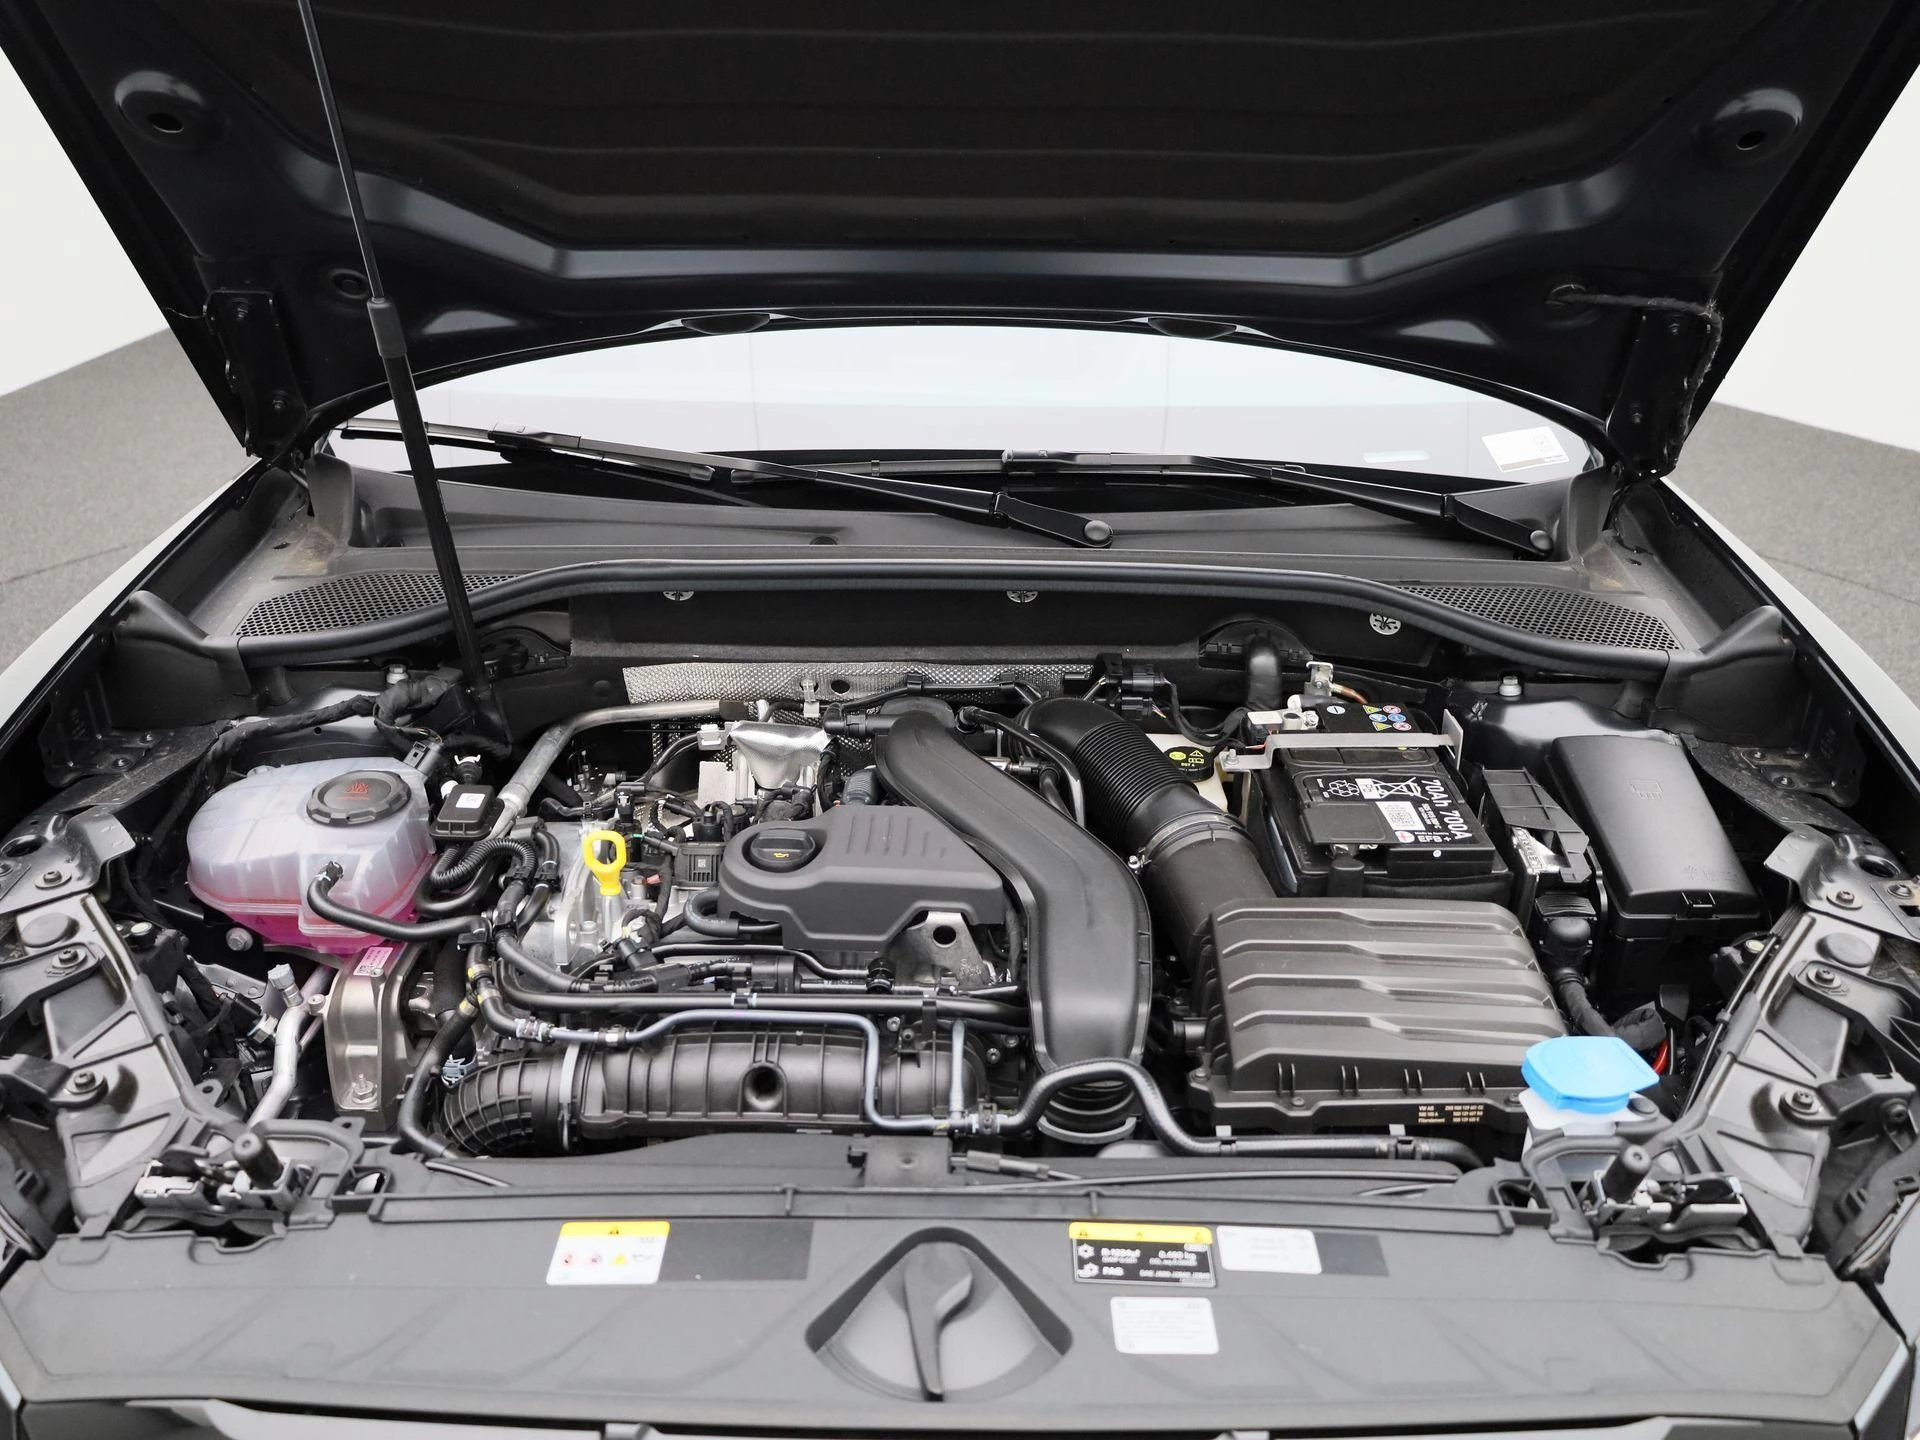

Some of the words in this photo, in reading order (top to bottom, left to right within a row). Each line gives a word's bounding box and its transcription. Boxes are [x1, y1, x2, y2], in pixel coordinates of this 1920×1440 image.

[1421, 779, 1452, 807] 70Ah
[1439, 810, 1473, 839] 700A
[1417, 835, 1443, 843] EFB
